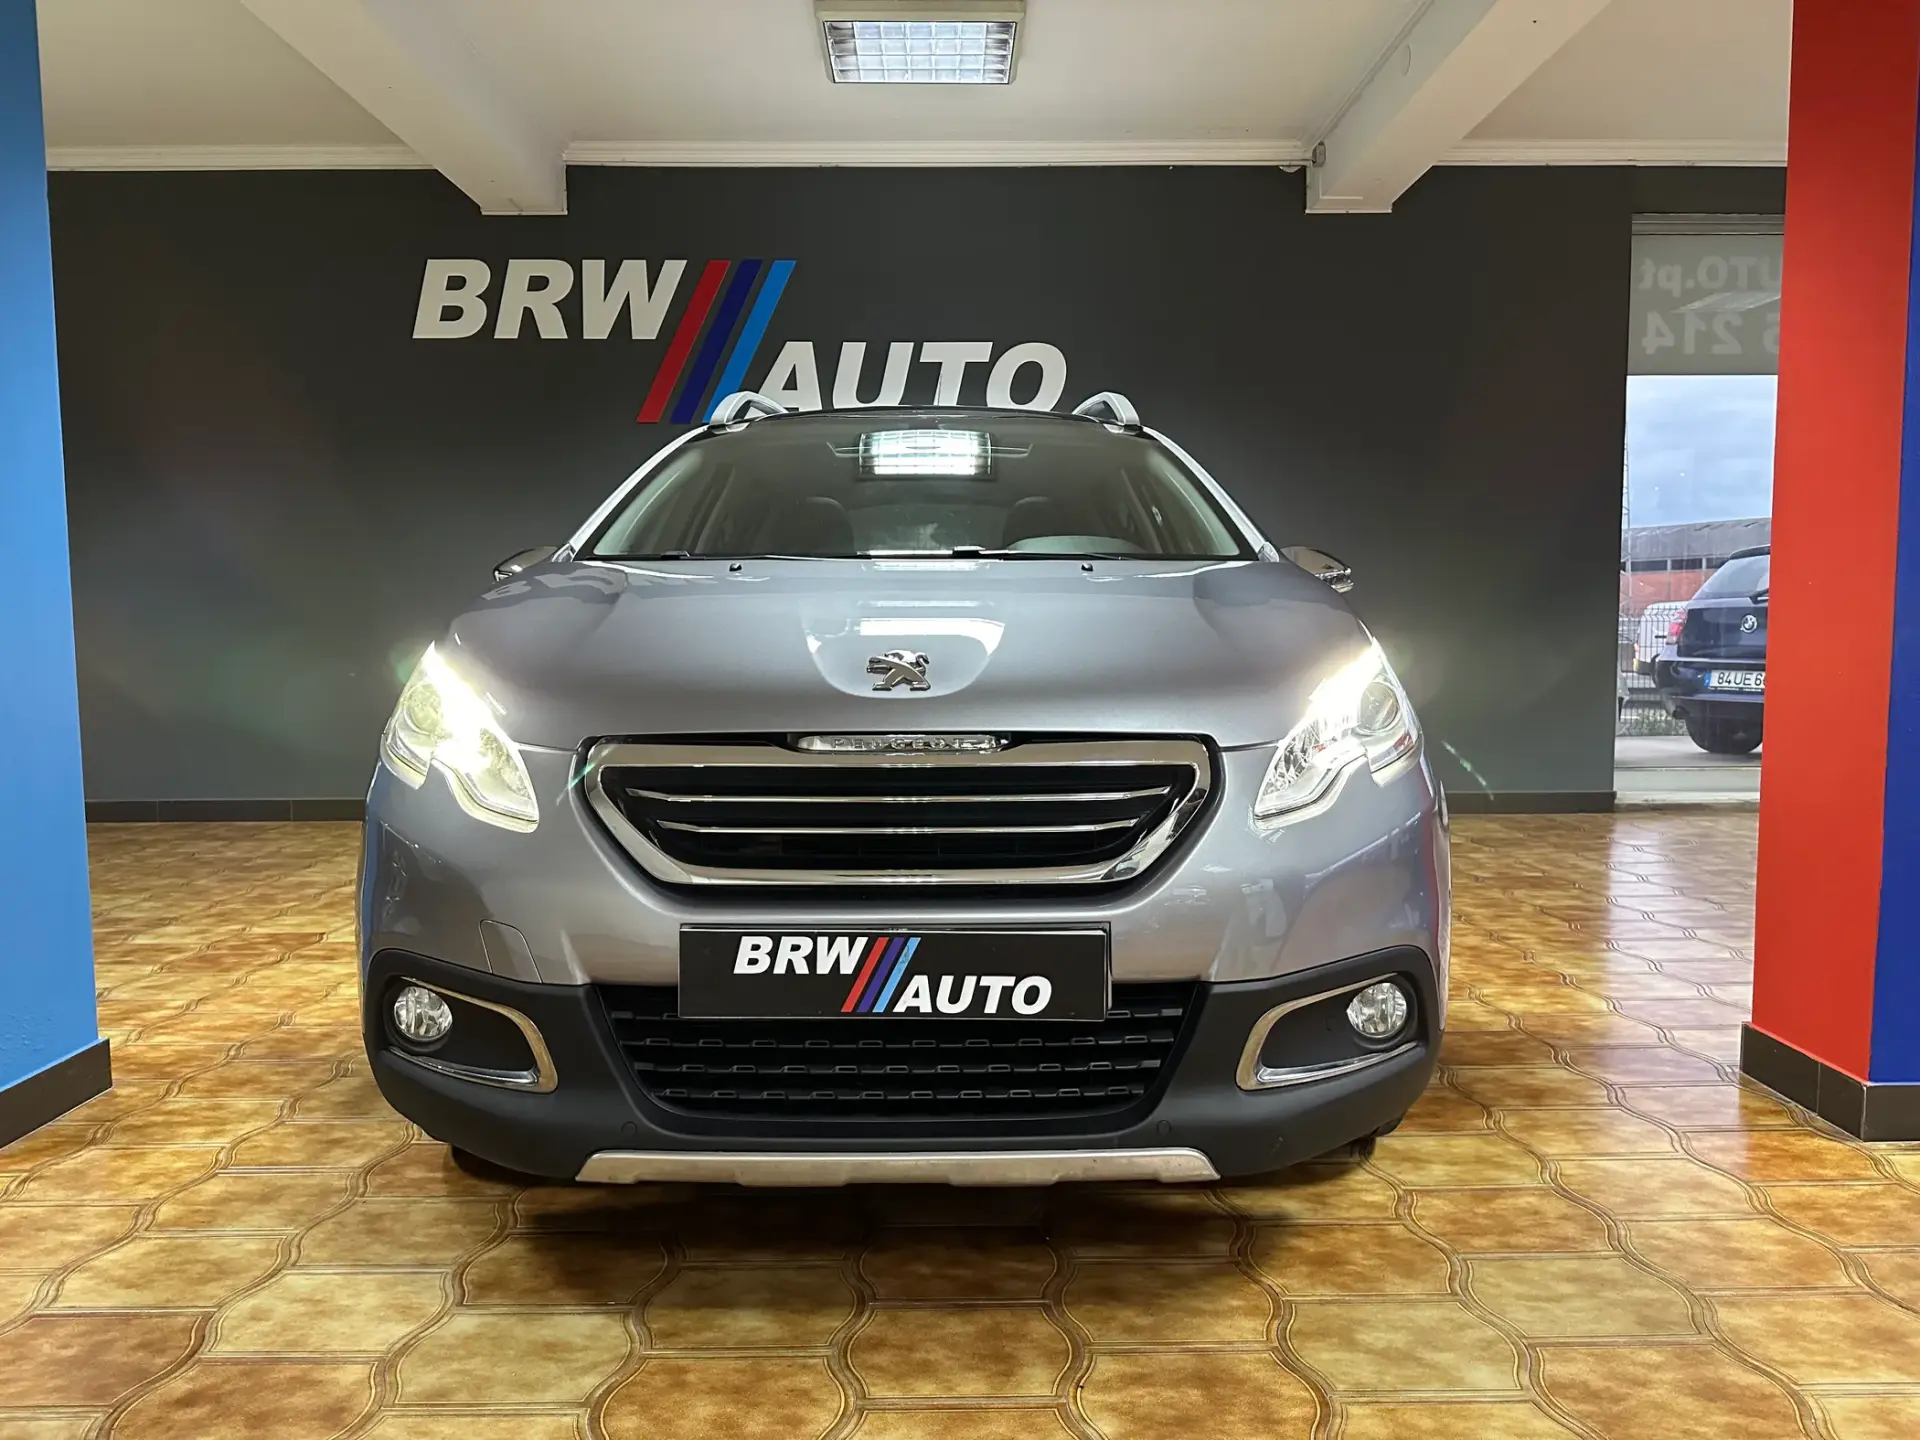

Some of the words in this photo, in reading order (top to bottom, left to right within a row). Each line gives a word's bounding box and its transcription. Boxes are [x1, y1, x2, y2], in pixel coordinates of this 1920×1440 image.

[412, 259, 688, 339] BRW
[743, 341, 1067, 415] AUTO
[831, 737, 966, 750] PEUGEOT
[733, 936, 869, 974] BRW
[892, 975, 1052, 1014] AUTO
